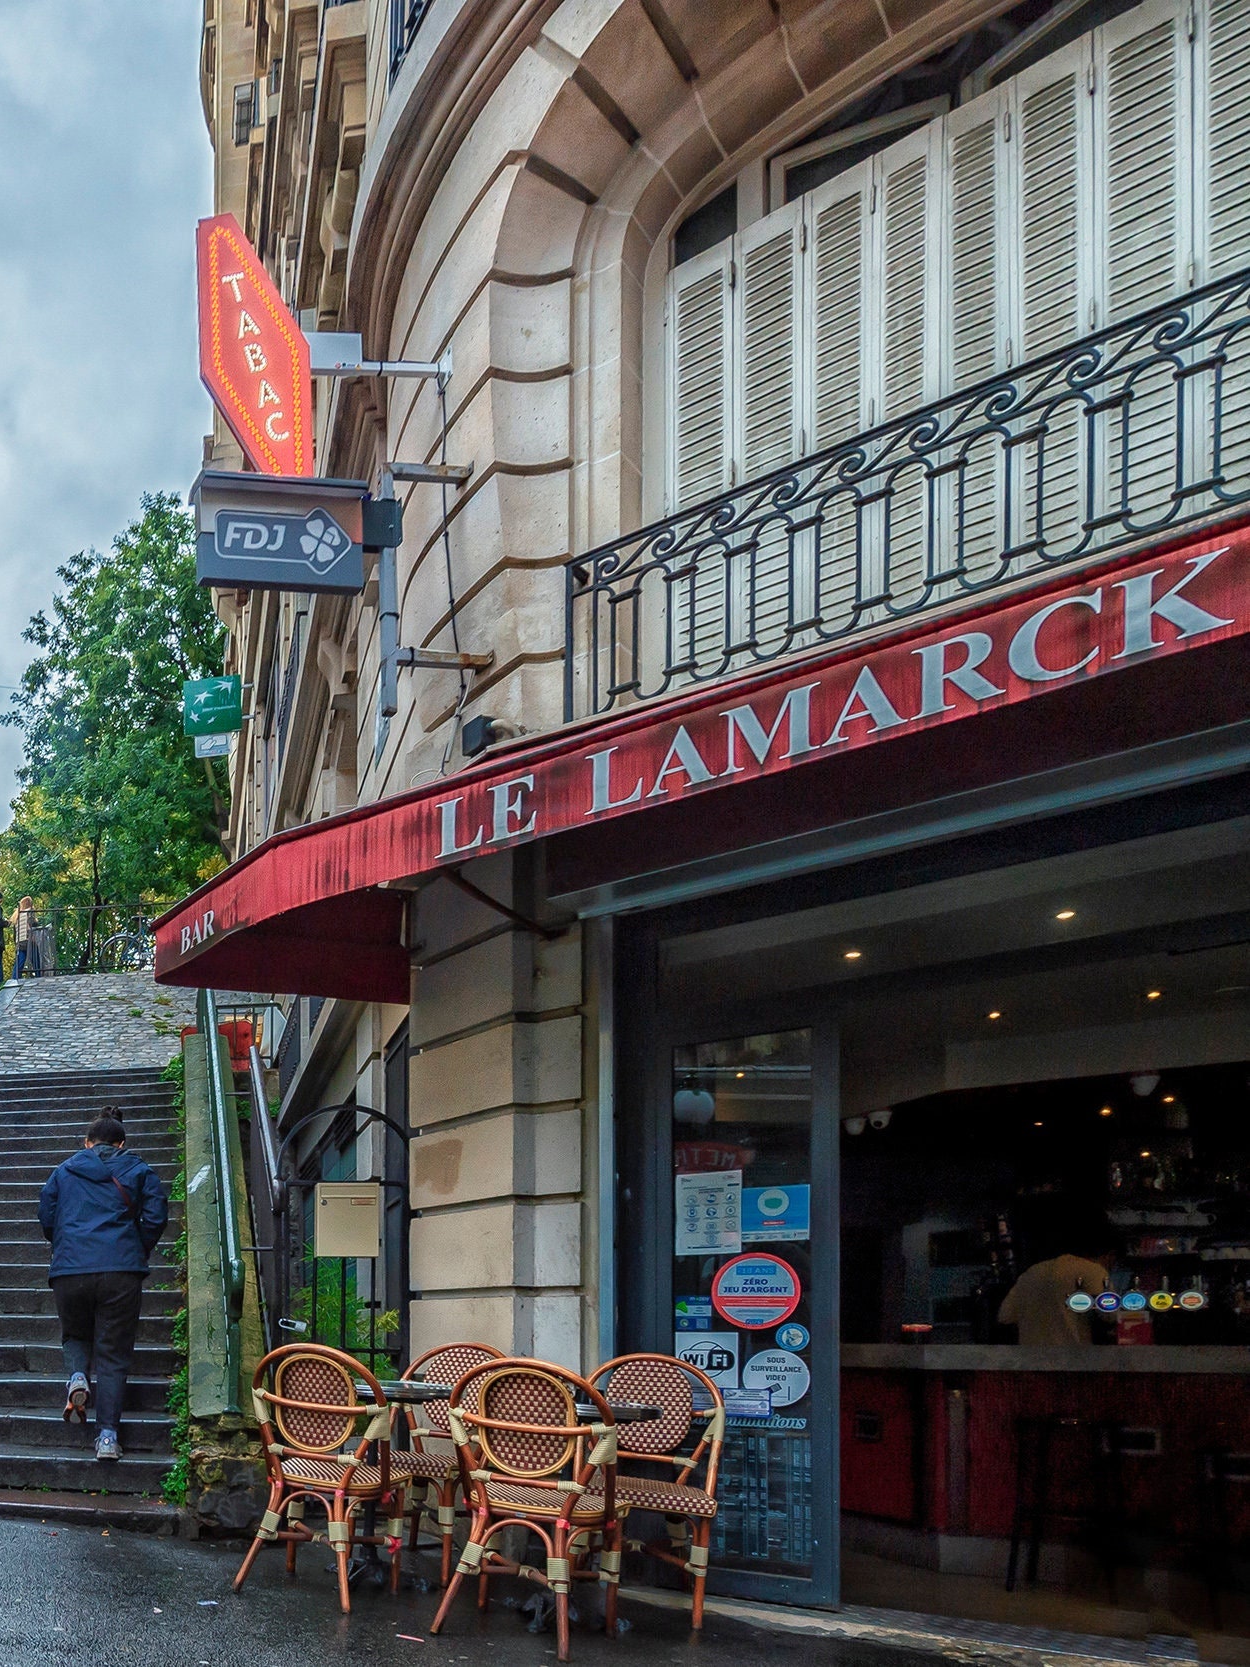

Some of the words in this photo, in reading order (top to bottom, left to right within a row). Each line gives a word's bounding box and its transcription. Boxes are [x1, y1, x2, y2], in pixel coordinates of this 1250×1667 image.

[220, 271, 290, 442] TABAC
[223, 520, 286, 551] FDJ
[434, 773, 538, 859] LE
[583, 546, 1236, 817] LAMARCK
[179, 909, 215, 956] BAR
[743, 1277, 768, 1286] ZÉRO
[750, 1365, 802, 1373] SURVEILLANCE
[766, 1356, 786, 1364] SOUS
[765, 1374, 787, 1382] VIDEO
